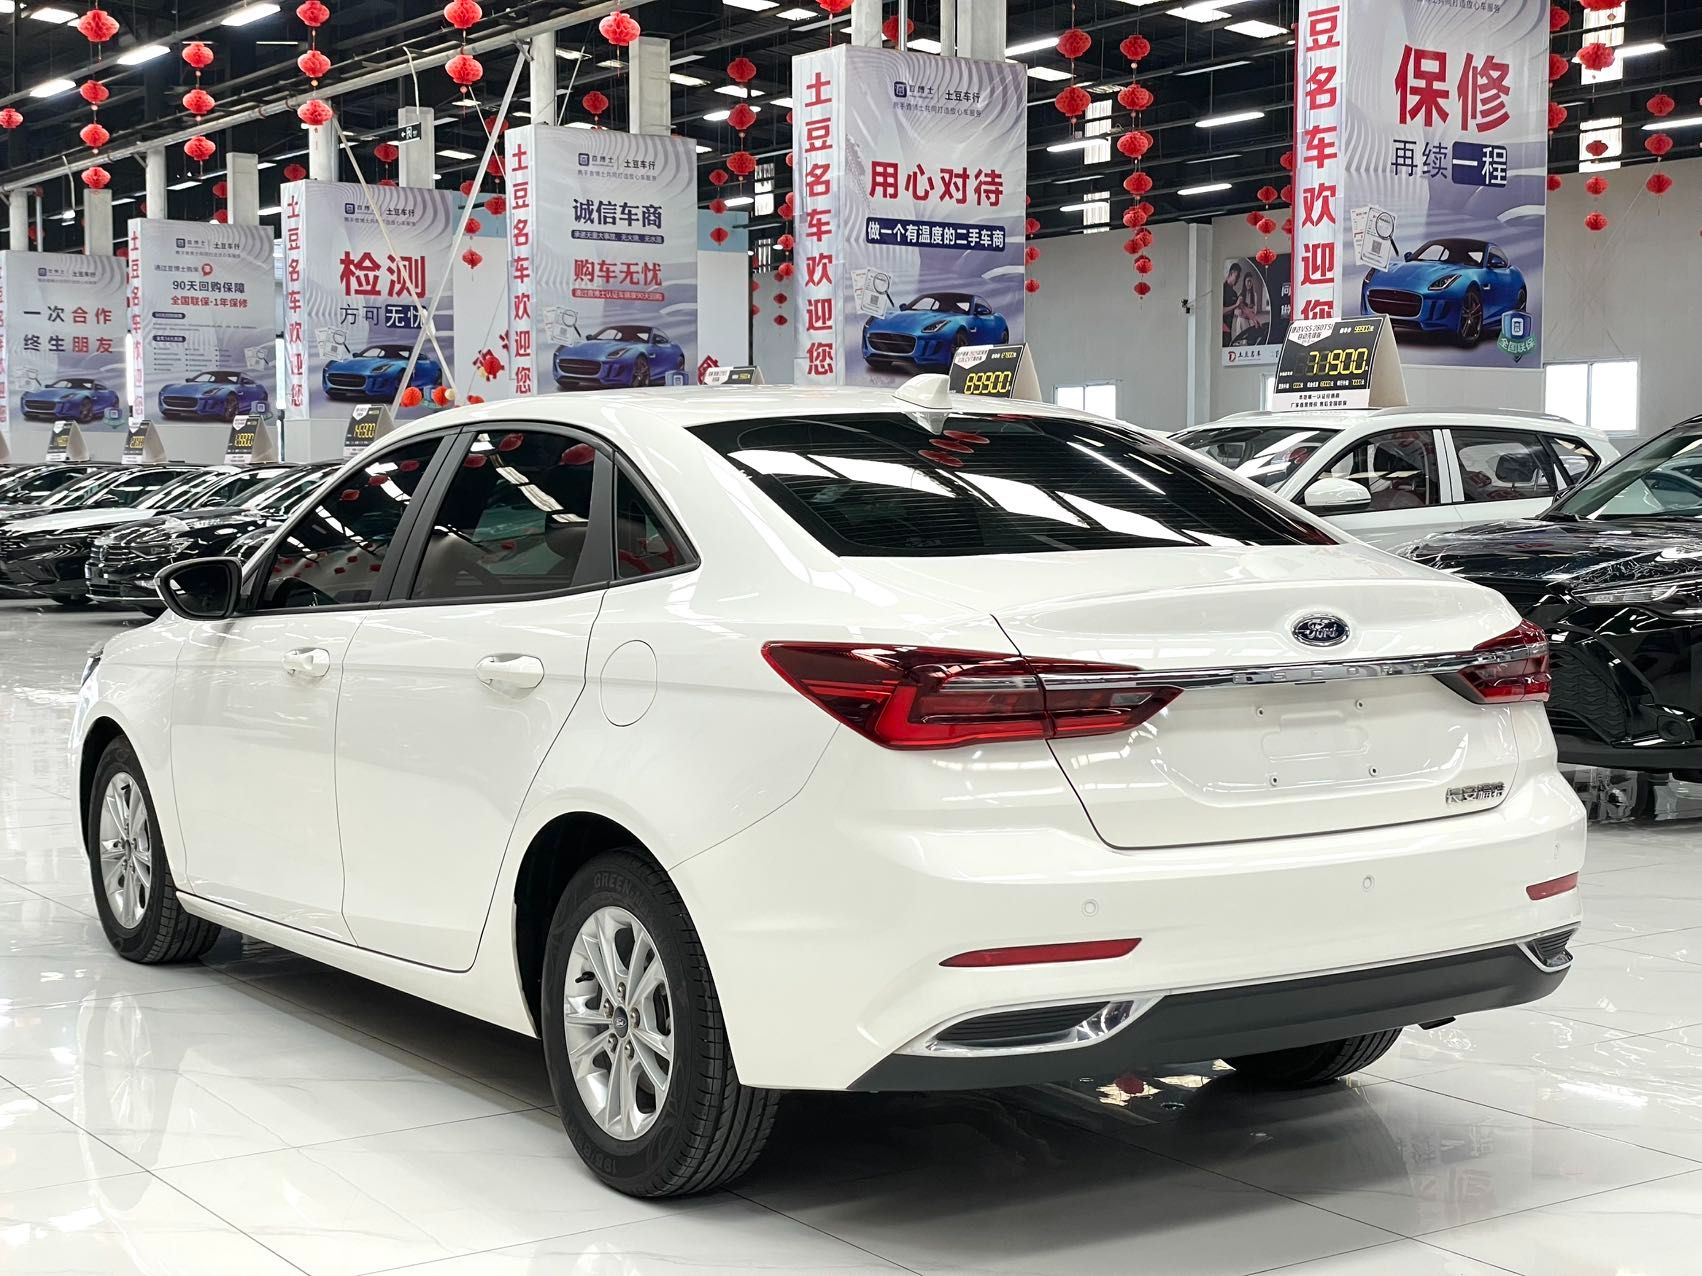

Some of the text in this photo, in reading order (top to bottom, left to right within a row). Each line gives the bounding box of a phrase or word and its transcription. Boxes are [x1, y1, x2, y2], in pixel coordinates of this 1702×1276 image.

[945, 90, 981, 103] 土豆车行
[1395, 45, 1511, 132] 保修
[624, 160, 656, 170] 土豆车行
[1391, 140, 1507, 184] 再续一程
[869, 161, 1003, 206] 用心对待
[573, 199, 662, 229] 诚信车商
[804, 72, 833, 376] 土豆名车欢迎您
[868, 221, 1004, 248] 做一个有温度的二手车商
[340, 251, 425, 298] 检测
[511, 144, 531, 394] 土豆名车欢迎您
[574, 259, 662, 286] 购车无忧
[173, 280, 245, 293] 90天回购保障
[287, 195, 303, 406] 土豆名车欢迎您
[24, 305, 112, 324] 一次合作
[24, 334, 113, 353] 终生朋友
[964, 371, 1011, 394] 89900
